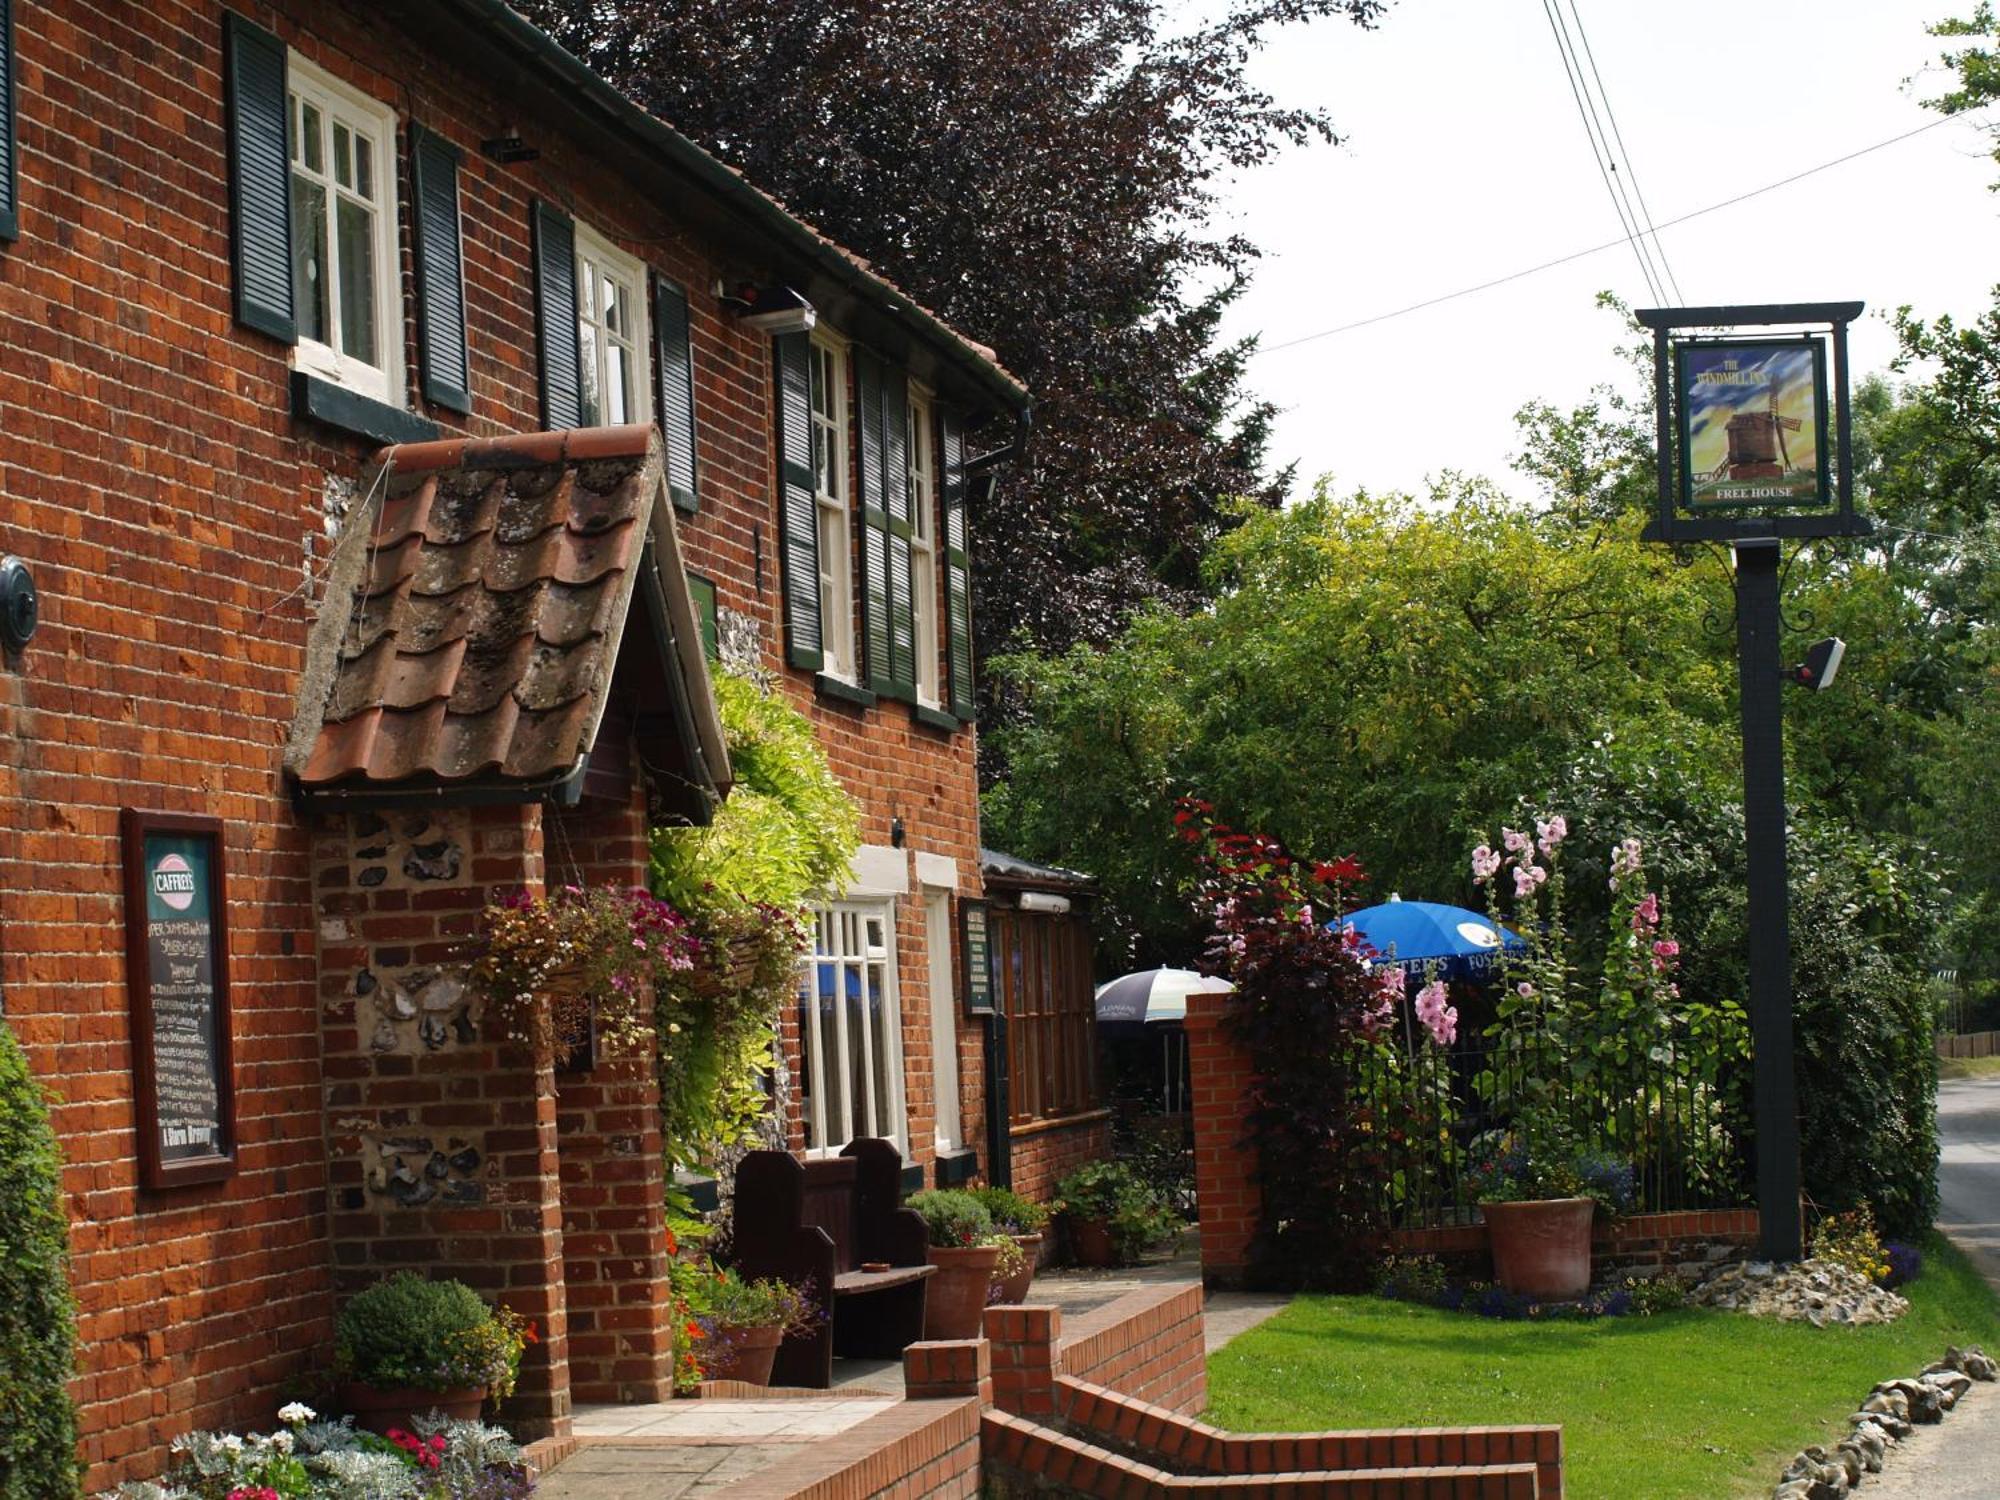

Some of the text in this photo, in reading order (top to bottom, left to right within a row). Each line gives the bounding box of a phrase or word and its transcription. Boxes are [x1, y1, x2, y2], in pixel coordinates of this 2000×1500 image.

[1724, 360, 1739, 371] THE
[1696, 371, 1767, 385] WINDMILL INN
[1716, 488, 1748, 499] FREE
[1751, 486, 1793, 498] HOUSE
